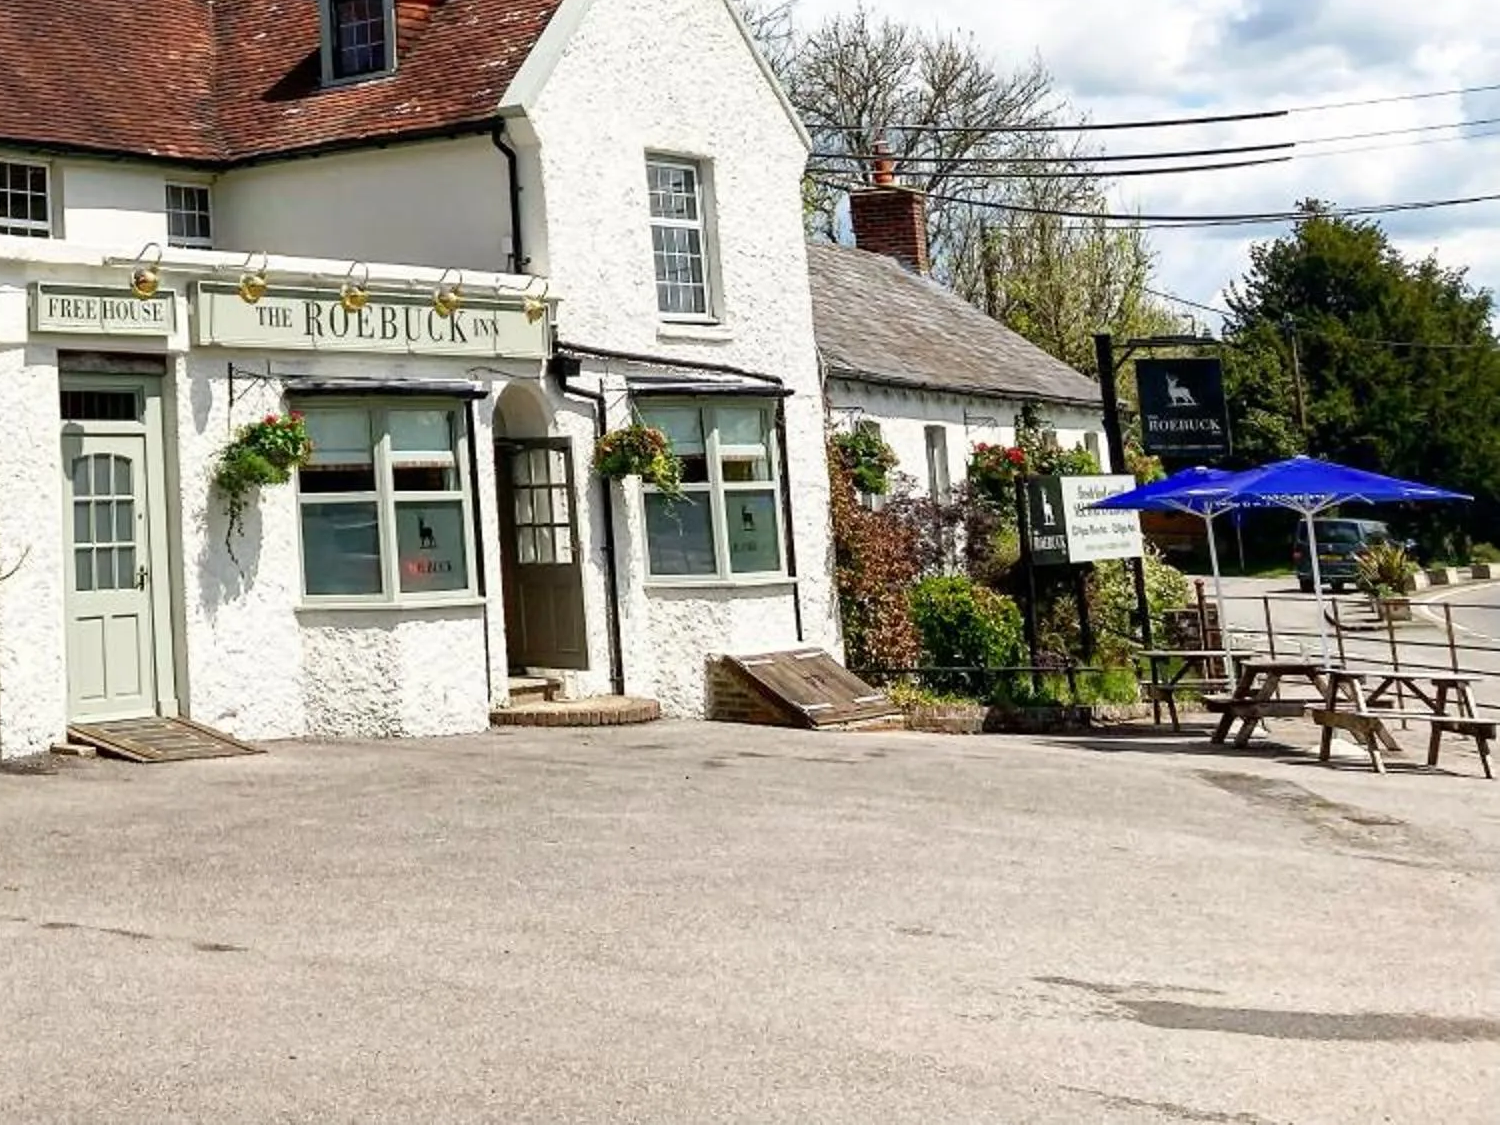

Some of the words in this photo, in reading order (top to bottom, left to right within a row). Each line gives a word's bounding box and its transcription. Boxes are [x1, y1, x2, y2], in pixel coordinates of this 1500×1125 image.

[48, 298, 97, 320] FREE
[102, 300, 164, 322] HOUSE
[255, 305, 293, 328] THE
[303, 300, 468, 343] ROEBUCK
